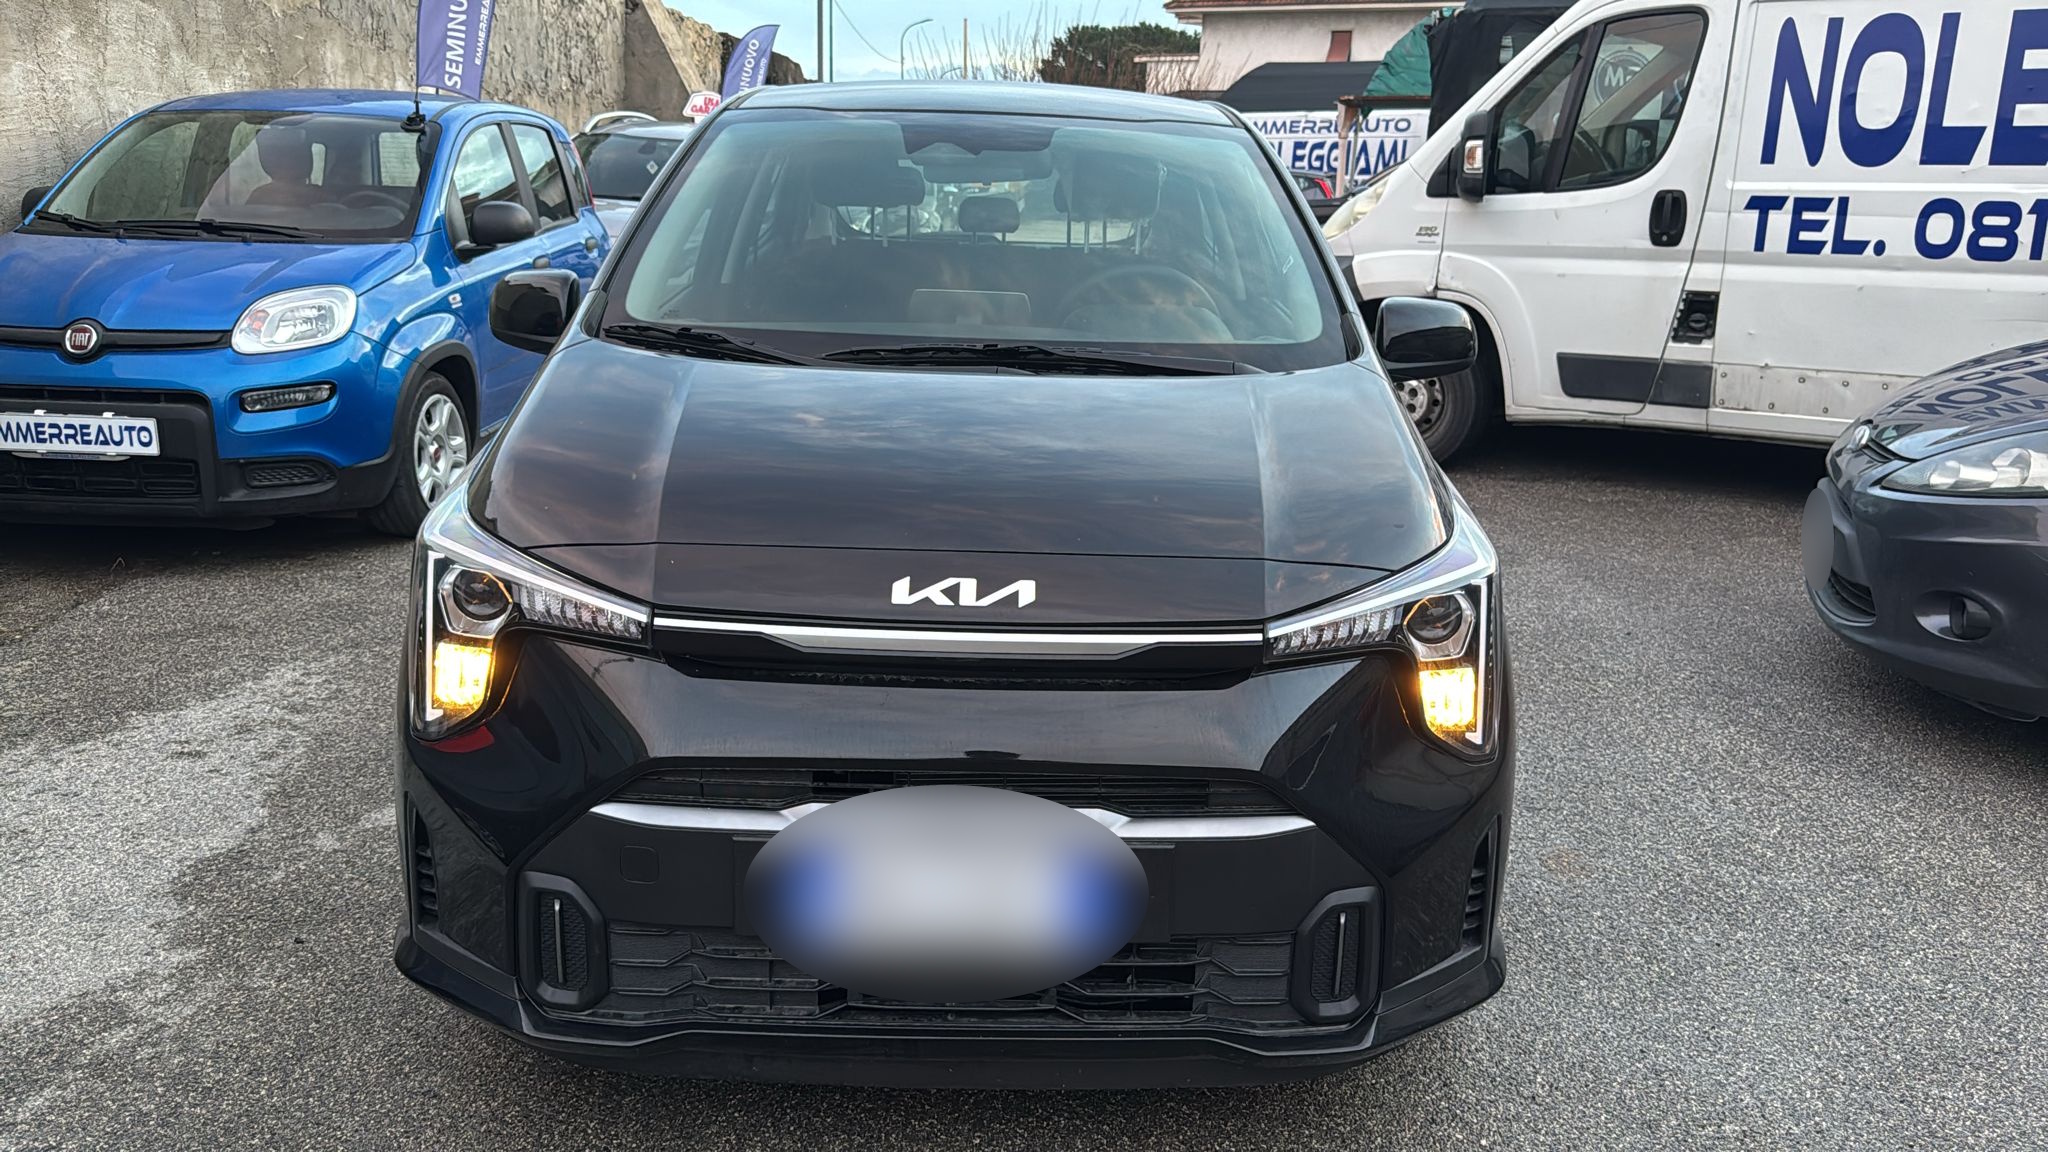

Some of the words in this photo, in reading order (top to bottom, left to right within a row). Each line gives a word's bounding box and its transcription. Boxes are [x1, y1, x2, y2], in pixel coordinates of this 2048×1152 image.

[1760, 9, 2048, 167] NOLE
[1743, 195, 1886, 257] TEL.
[1914, 198, 2048, 262] 081
[71, 331, 91, 346] FIAT
[891, 576, 1036, 609] KIA
